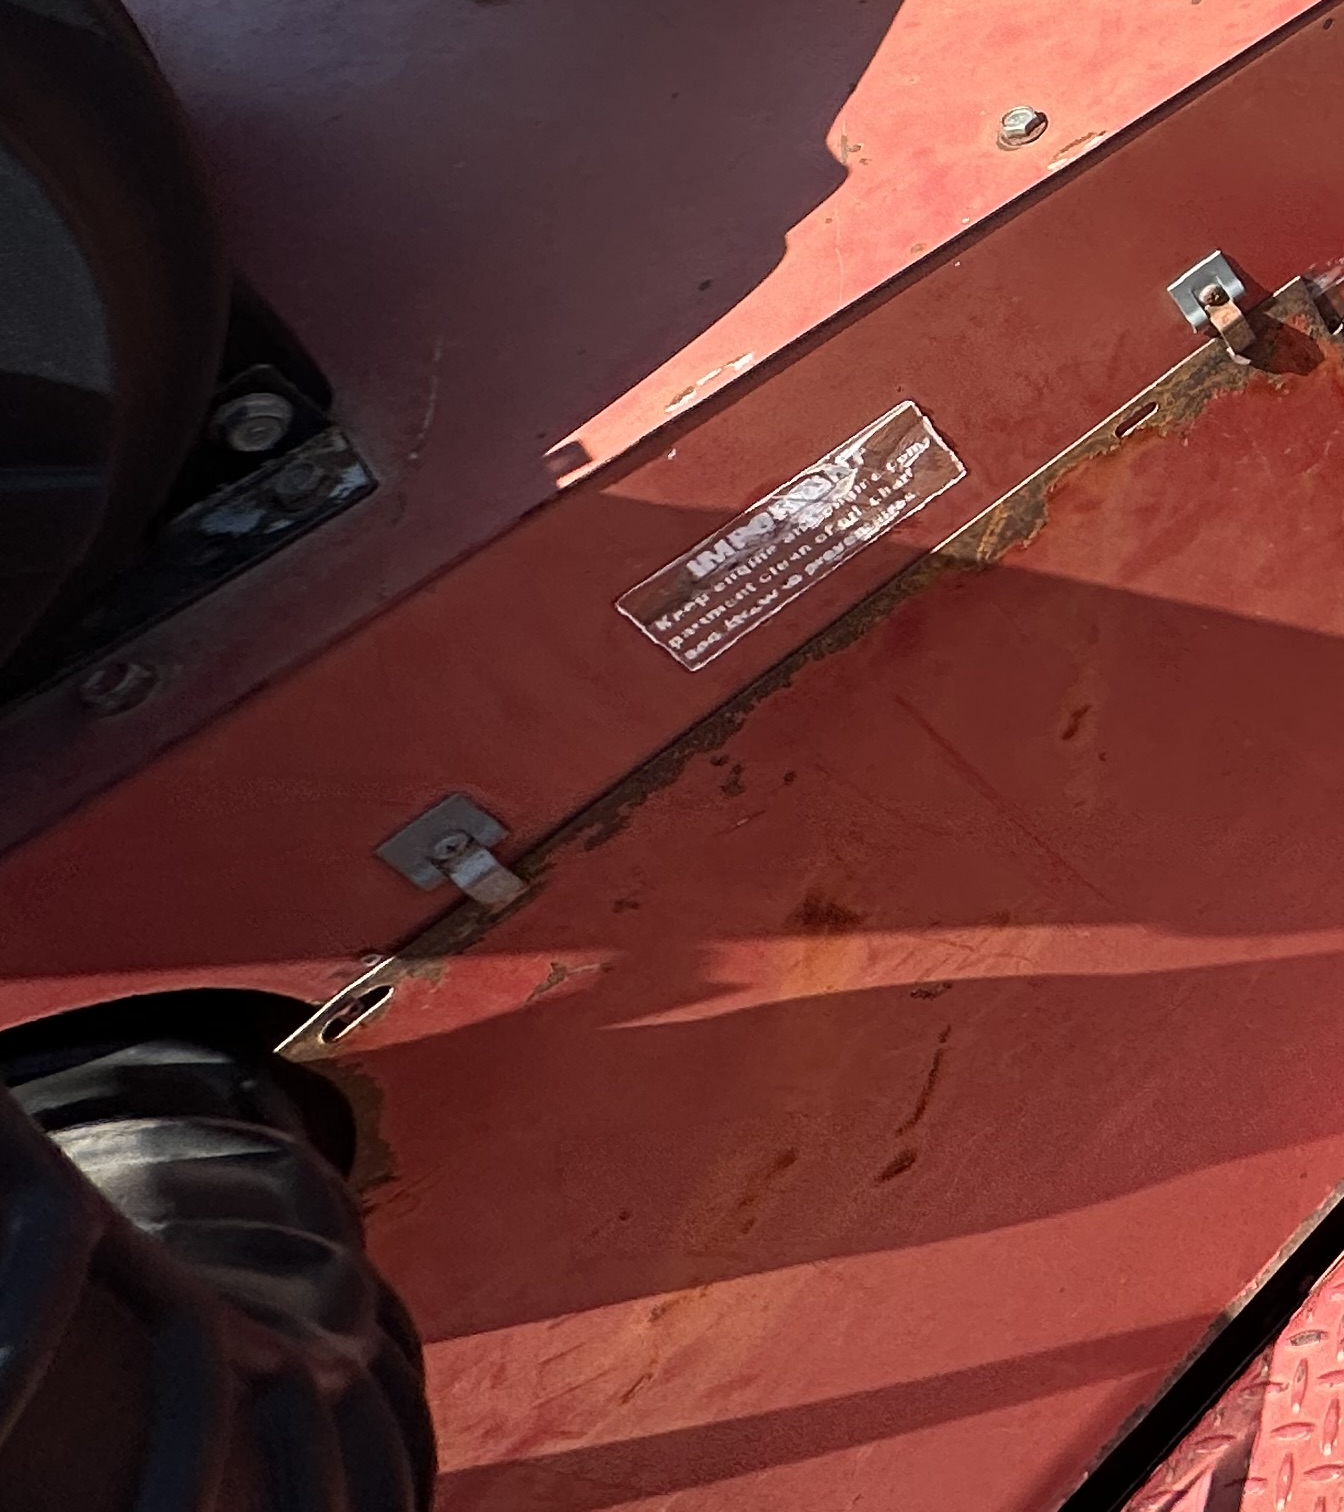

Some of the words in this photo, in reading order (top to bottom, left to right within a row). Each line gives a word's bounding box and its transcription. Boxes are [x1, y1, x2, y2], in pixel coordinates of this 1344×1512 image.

[686, 447, 867, 577] IMPORNT
[655, 592, 710, 631] Keep
[714, 544, 777, 592] engine
[669, 582, 757, 650] partment
[759, 544, 813, 584] clean
[815, 523, 835, 545] of
